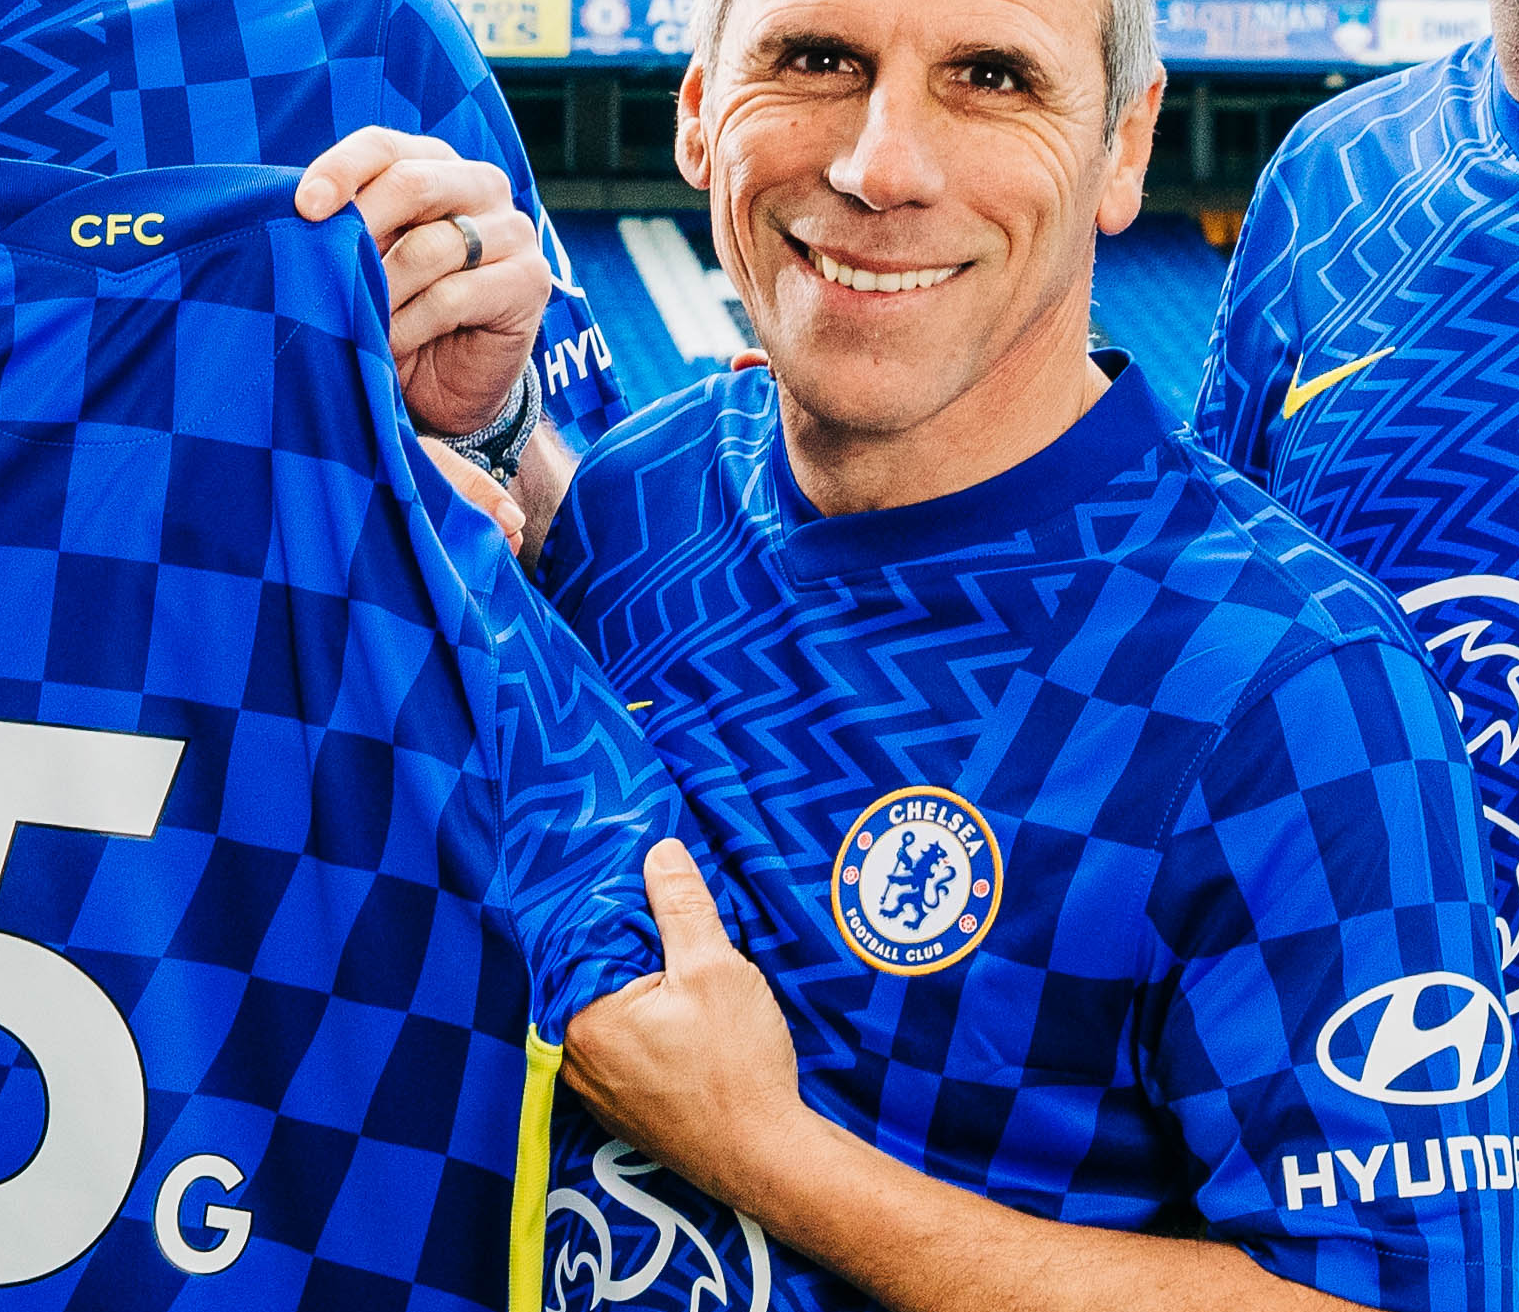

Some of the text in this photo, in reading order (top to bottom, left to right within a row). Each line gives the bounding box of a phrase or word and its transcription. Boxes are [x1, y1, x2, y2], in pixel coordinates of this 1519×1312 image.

[70, 212, 165, 248] CFC
[888, 800, 985, 858] CHELSEA
[845, 906, 944, 963] FOOTBALL CLUB
